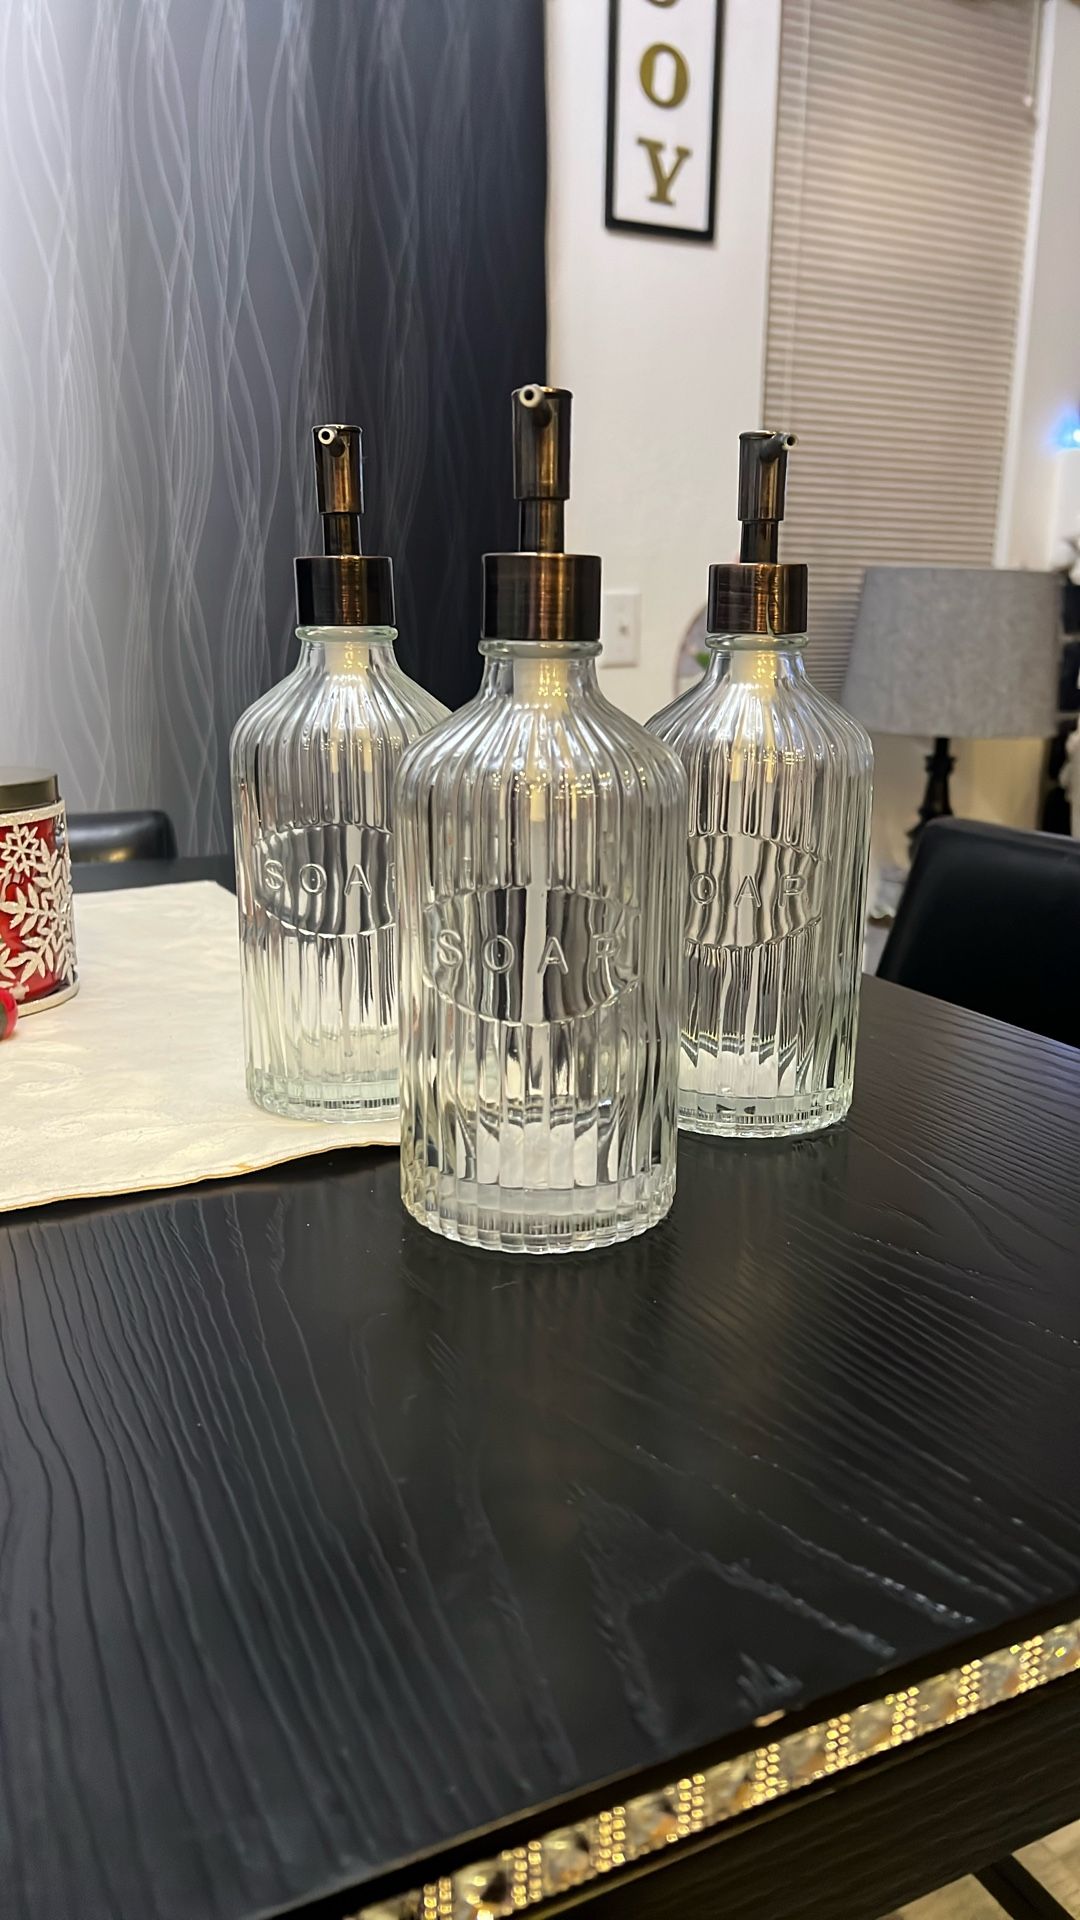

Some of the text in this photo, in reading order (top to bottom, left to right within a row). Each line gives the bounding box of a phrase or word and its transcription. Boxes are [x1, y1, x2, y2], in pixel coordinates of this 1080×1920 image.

[637, 0, 692, 206] OY
[690, 872, 807, 908] OAP
[437, 929, 620, 974] SOAP
